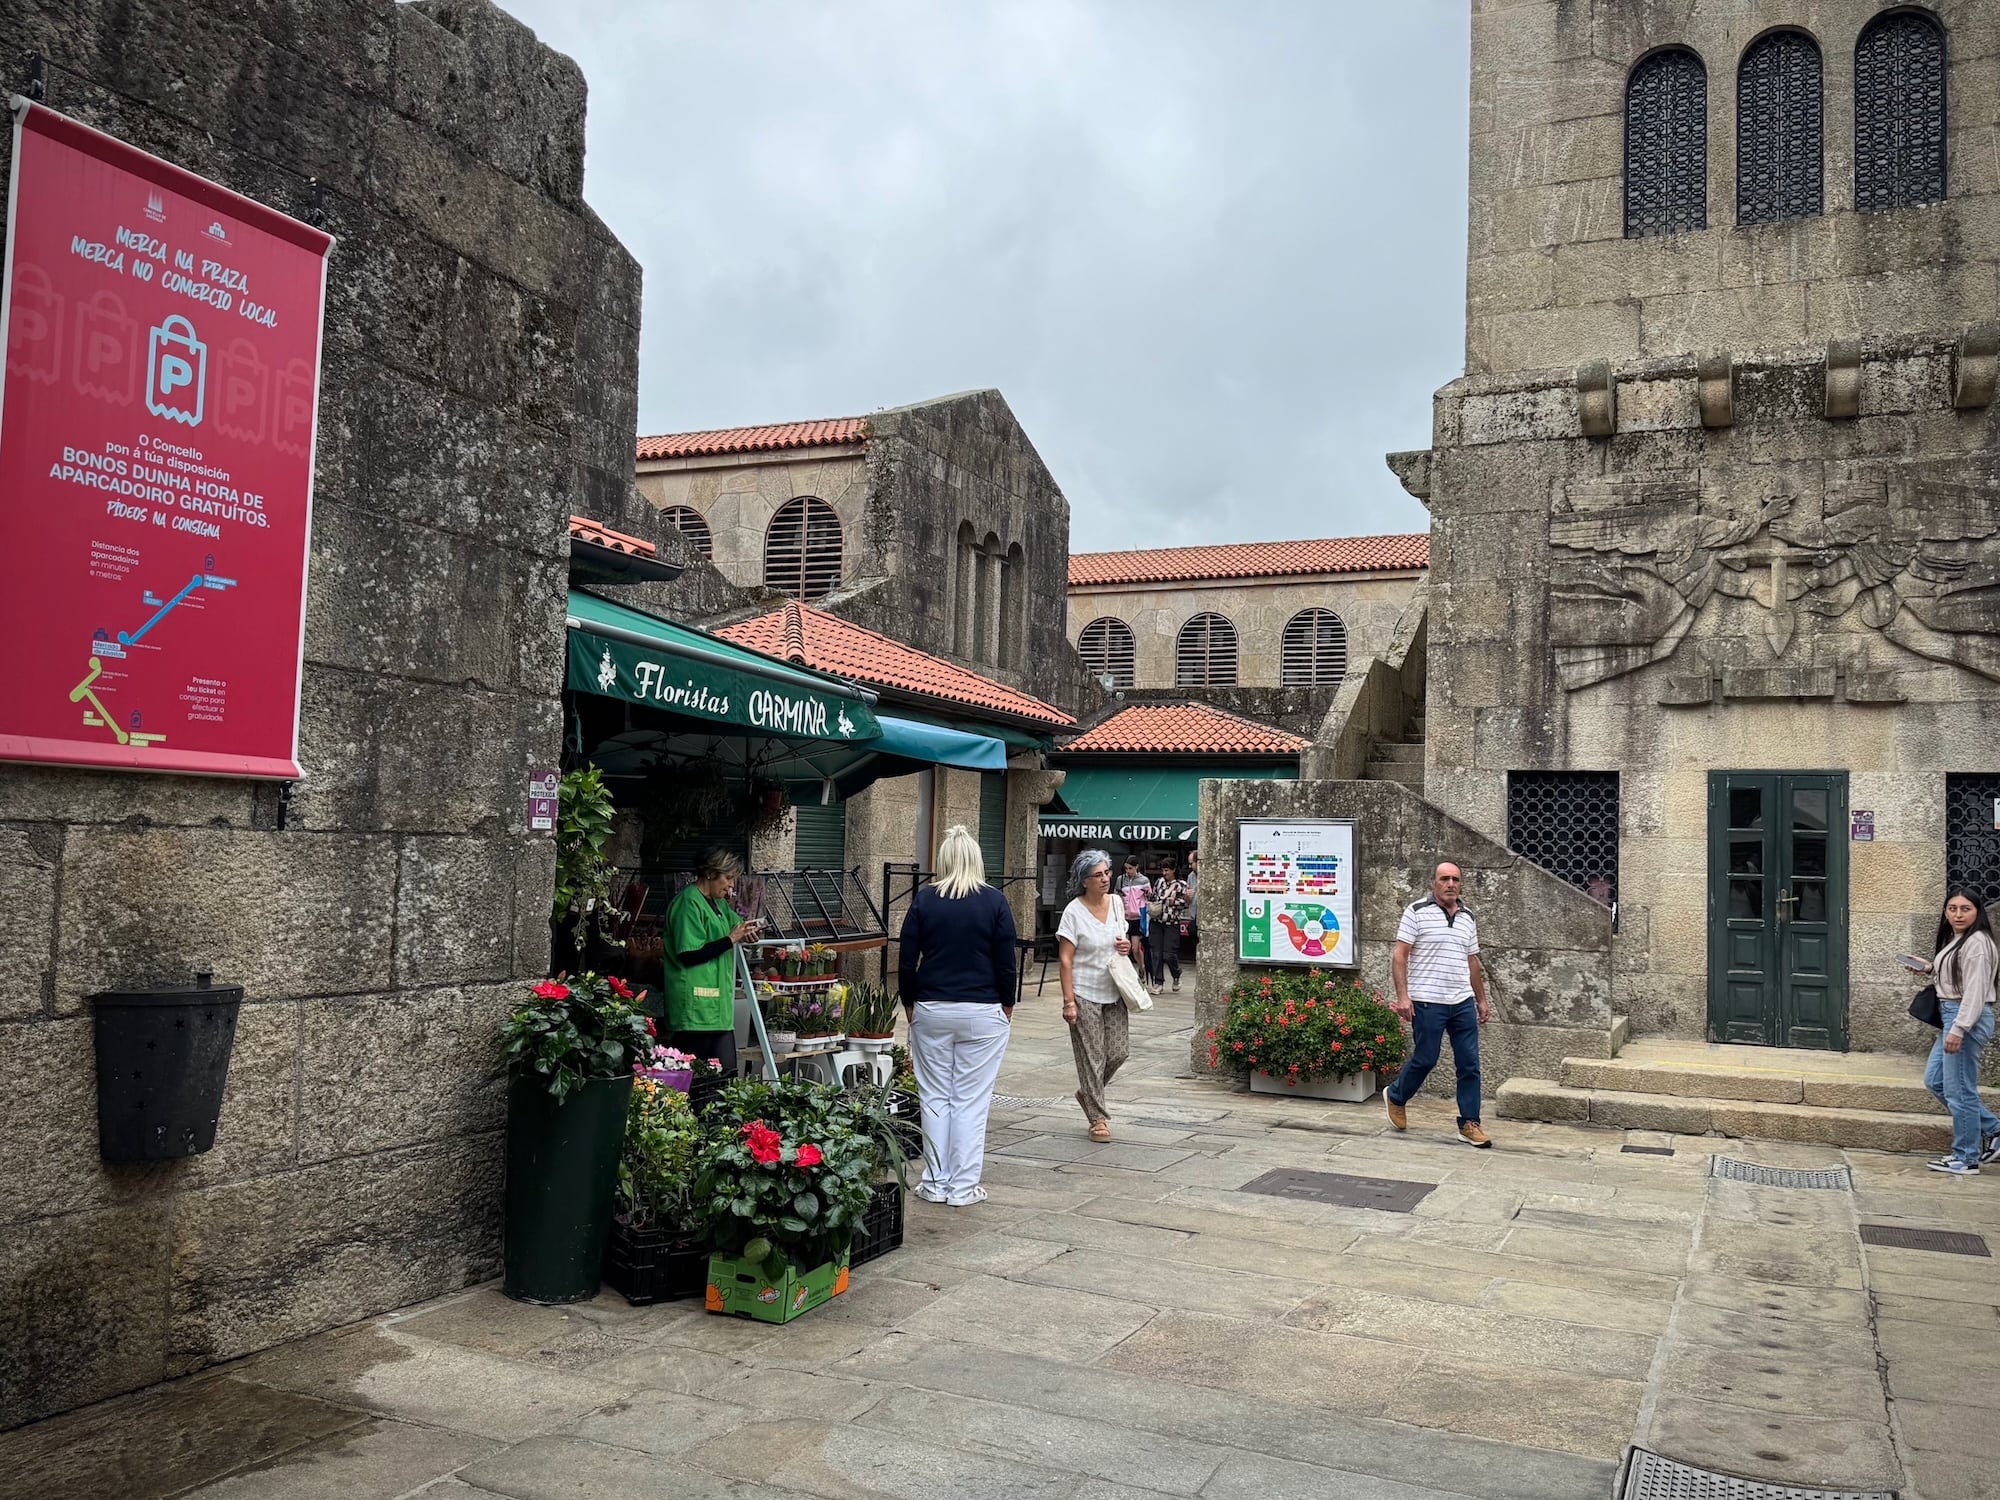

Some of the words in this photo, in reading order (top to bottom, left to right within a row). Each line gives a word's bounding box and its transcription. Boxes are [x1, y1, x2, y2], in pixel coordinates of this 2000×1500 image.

[115, 225, 167, 264] MERCA
[174, 249, 195, 275] NA
[71, 235, 124, 274] MERCA
[132, 259, 154, 282] NO
[161, 270, 232, 311] COMERCIO
[239, 299, 278, 328] LOCAL
[138, 434, 149, 447] O
[152, 437, 203, 461] Concello
[105, 442, 130, 456] pon
[133, 447, 141, 458] á
[144, 450, 164, 465] túa
[167, 456, 230, 482] disposición
[63, 446, 128, 476] BONOS
[132, 464, 191, 492] DUNHA
[195, 481, 239, 504] HORA
[243, 492, 264, 509] DE
[49, 463, 175, 505] APARCADOIRO
[179, 495, 271, 529] GRATUÍTOS.
[107, 498, 148, 522] PÍDEOS
[152, 511, 166, 528] NA
[172, 515, 221, 540] CONSIGNA
[91, 551, 139, 566] aparcadoiros
[92, 540, 126, 555] Distancia
[126, 547, 140, 557] dos
[90, 560, 101, 568] en
[101, 561, 130, 573] minutos
[186, 685, 198, 693] teu
[198, 686, 217, 695] ticket
[192, 676, 220, 686] Presenta
[634, 661, 729, 715] Floristas
[179, 694, 209, 704] consigna
[209, 697, 225, 705] para
[192, 703, 219, 713] efectuar
[1119, 826, 1172, 840] GUDE
